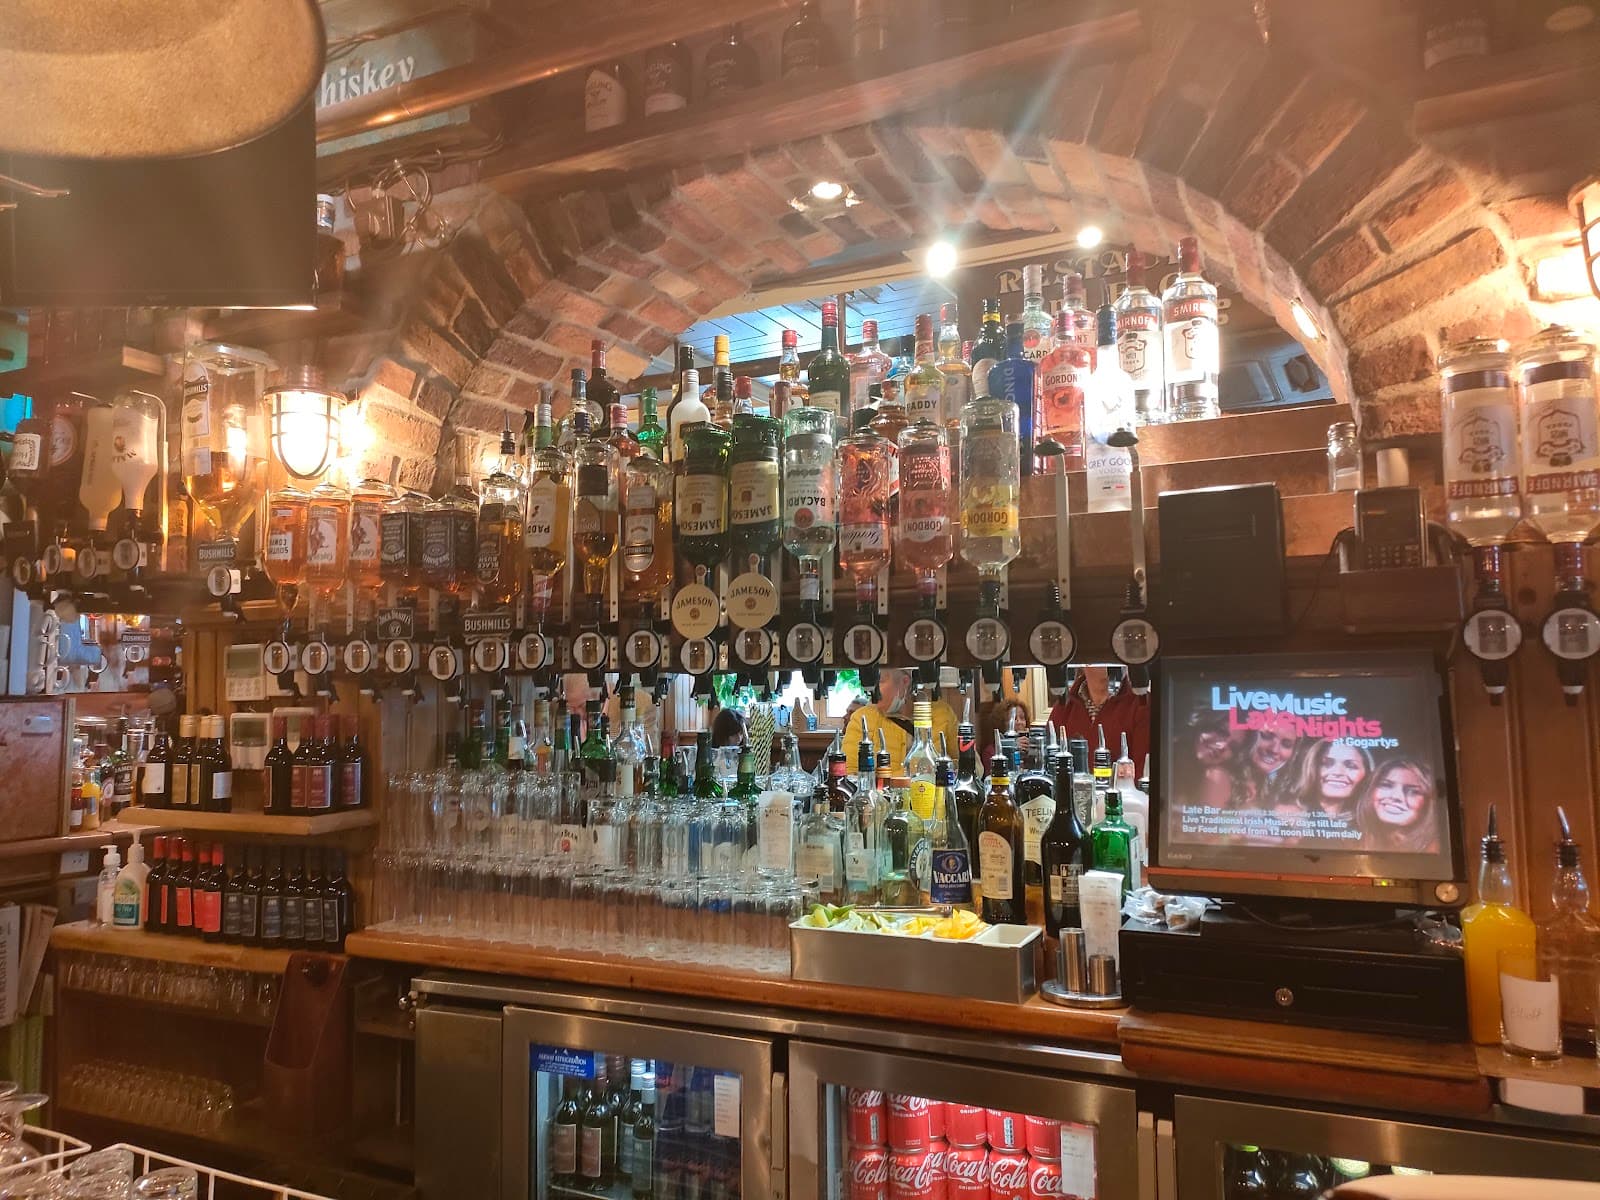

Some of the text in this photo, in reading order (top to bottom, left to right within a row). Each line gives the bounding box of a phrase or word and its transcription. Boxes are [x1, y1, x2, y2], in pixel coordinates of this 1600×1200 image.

[1108, 455, 1131, 467] GOO
[199, 544, 235, 561] BUSHMILLS
[730, 586, 771, 598] JAMESON
[676, 596, 714, 609] JAMESON
[464, 618, 511, 632] BUSHMILLS
[1346, 737, 1399, 749] Gogartys
[1182, 805, 1203, 815] Late
[1203, 806, 1222, 815] Bar
[1182, 816, 1200, 825] Live
[1200, 816, 1243, 826] Traditional
[1244, 817, 1264, 827] Irish
[1264, 818, 1289, 828] Music
[1296, 819, 1316, 830] days
[1317, 819, 1330, 829] till
[1182, 824, 1363, 841] Bar Food served from 12 noon till 11pm daily
